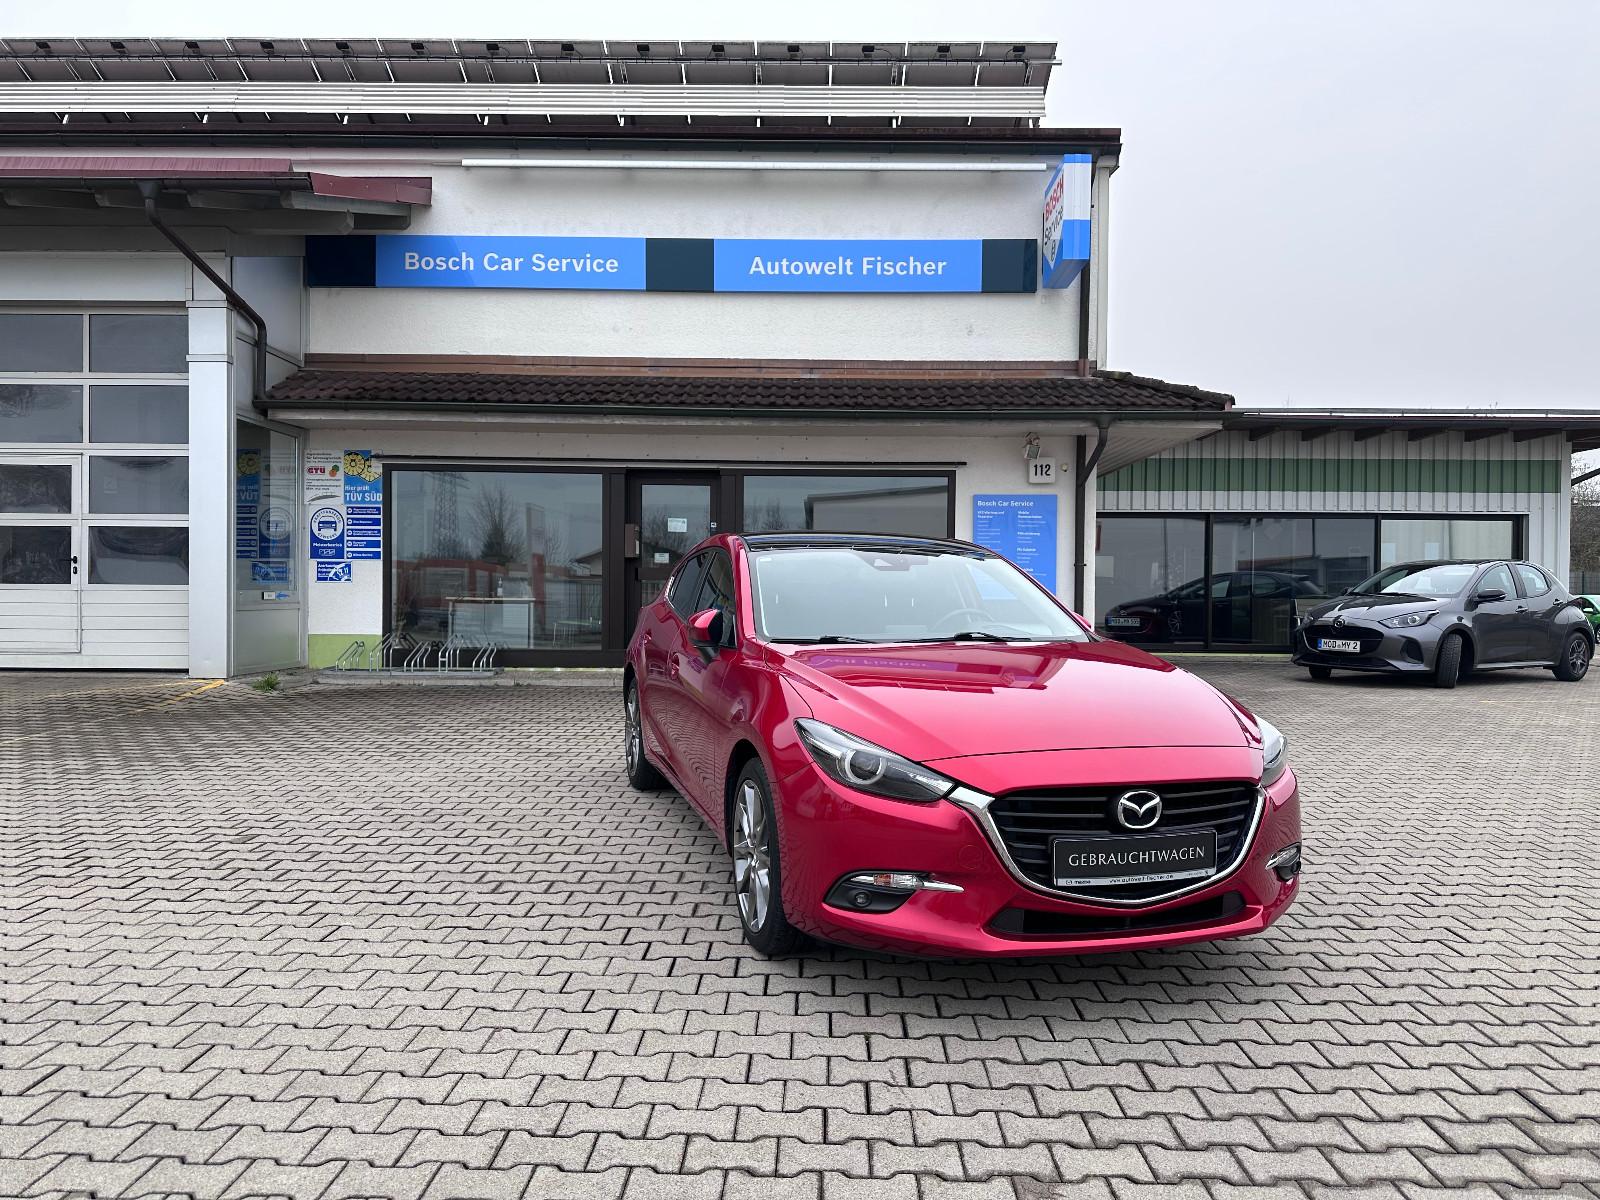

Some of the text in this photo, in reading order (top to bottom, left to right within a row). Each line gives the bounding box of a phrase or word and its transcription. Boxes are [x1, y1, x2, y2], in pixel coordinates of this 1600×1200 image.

[1045, 174, 1064, 221] BOSCH
[404, 251, 619, 273] Bosch Car Service
[749, 256, 947, 275] Autowelt Fischer
[1033, 463, 1051, 477] 112
[345, 491, 383, 501] TÜV SÜD
[1323, 640, 1358, 650] MOD MY 2
[1068, 845, 1206, 867] GEBRAUCHTWAGEN
